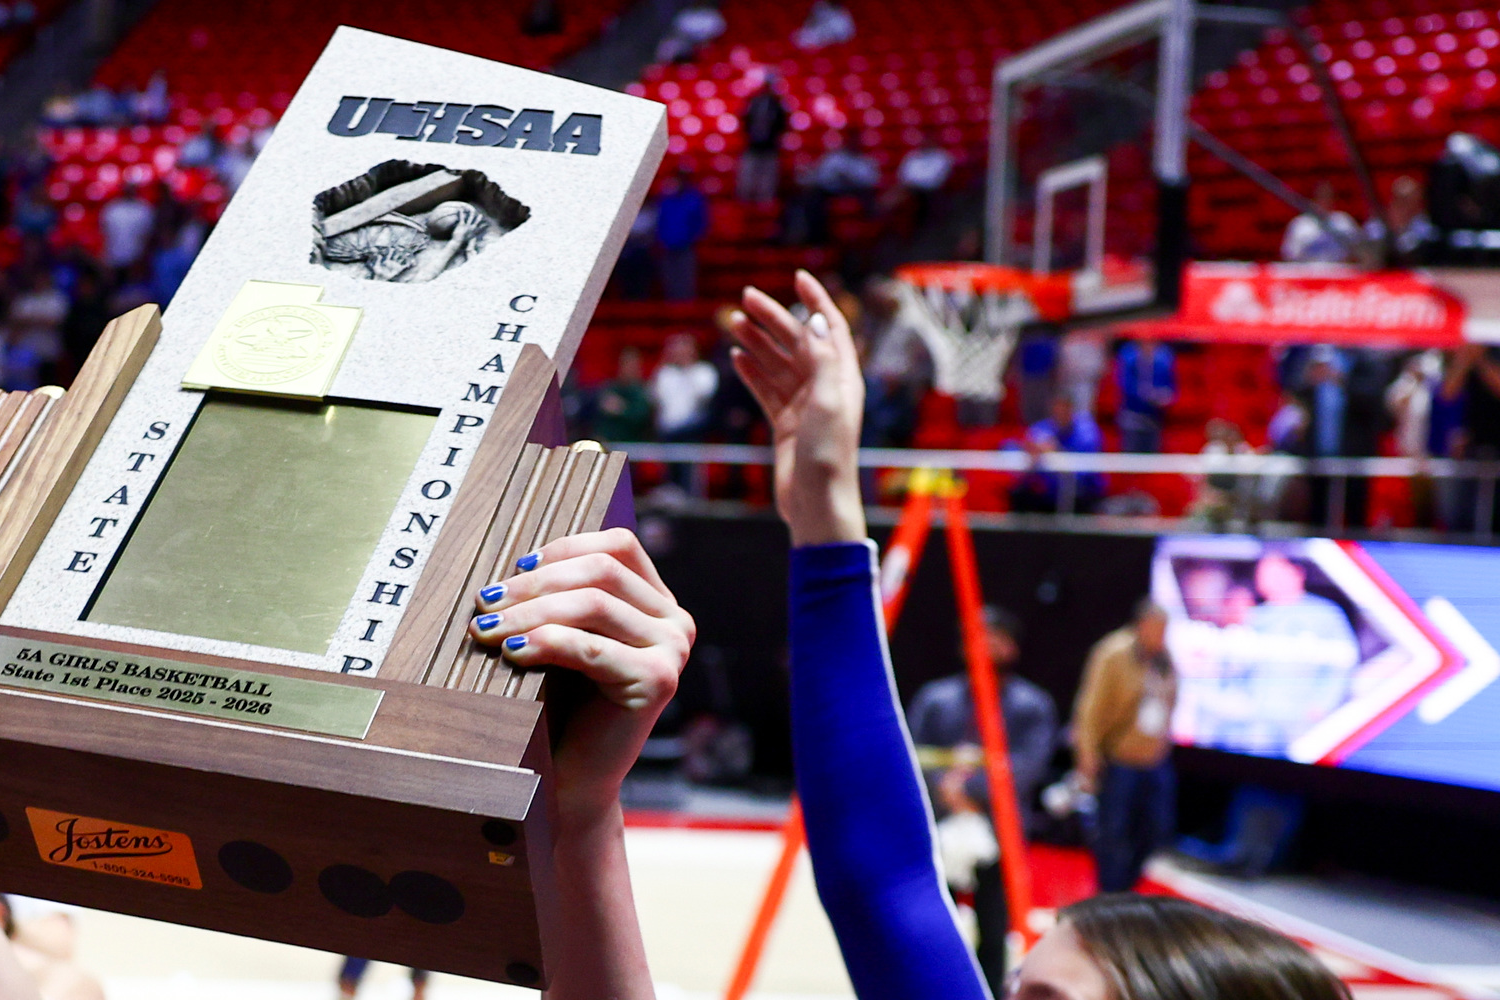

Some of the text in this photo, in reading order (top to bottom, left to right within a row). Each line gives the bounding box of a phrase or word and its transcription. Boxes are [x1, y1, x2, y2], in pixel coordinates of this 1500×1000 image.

[64, 420, 171, 574] STATE
[340, 294, 538, 675] CHAMPIONSHIP
[1, 662, 55, 683] State
[59, 671, 91, 688] 1st
[94, 676, 153, 698] Place
[156, 686, 207, 706] 2025
[221, 696, 273, 716] 2026
[15, 647, 273, 698] 5A GIRLS BASKETBALL
[49, 818, 173, 863] Jostens
